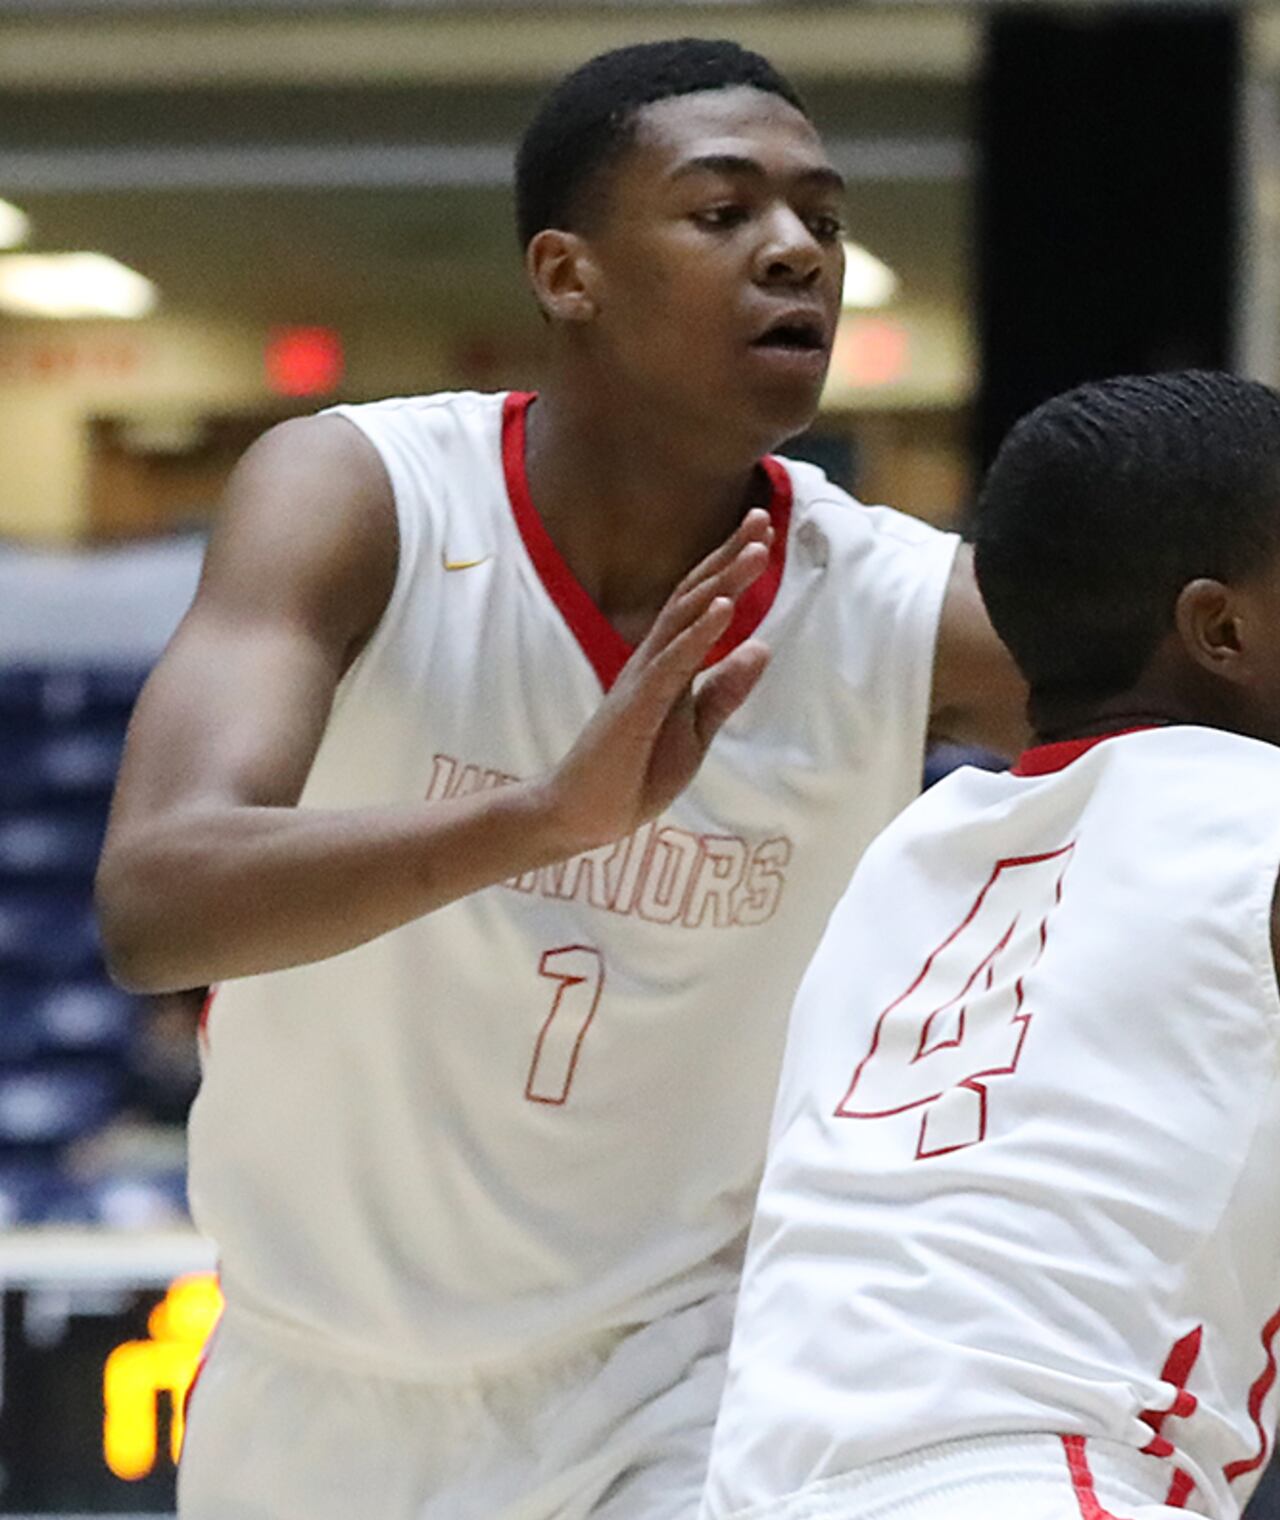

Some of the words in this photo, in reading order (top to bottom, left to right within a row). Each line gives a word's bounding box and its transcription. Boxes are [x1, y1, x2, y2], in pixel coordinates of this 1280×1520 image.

[424, 753, 793, 929] WRIORS
[524, 944, 605, 1105] 1
[834, 841, 1075, 1160] 4
